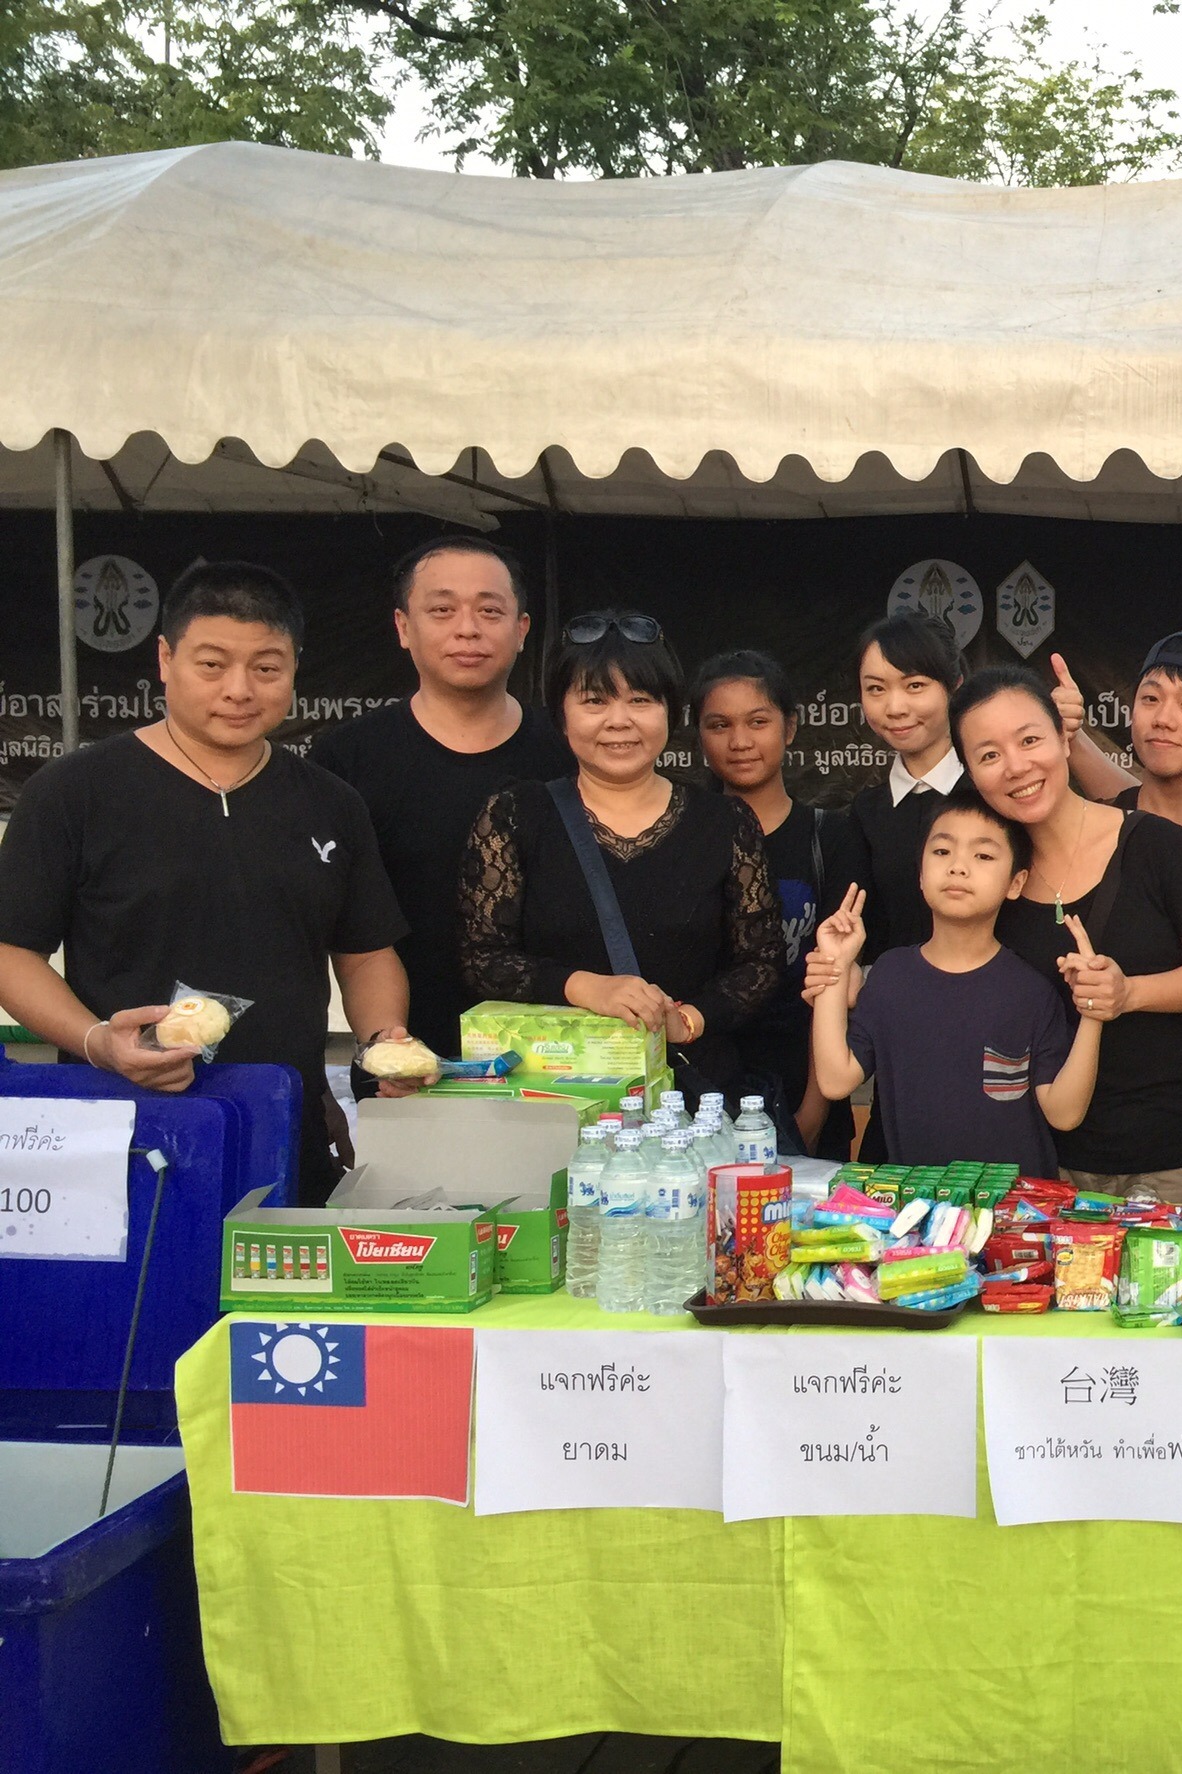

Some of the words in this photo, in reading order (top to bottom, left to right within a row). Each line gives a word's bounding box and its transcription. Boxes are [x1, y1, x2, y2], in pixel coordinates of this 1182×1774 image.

[540, 1363, 650, 1393] แจกฟรีค่ะ
[793, 1367, 901, 1395] แจกฟรีค่ะ
[1060, 1366, 1140, 1405] 台灣
[562, 1440, 628, 1462] ยาดม
[800, 1425, 889, 1463] ขนม/น้ำ
[1015, 1437, 1102, 1460] ชาวไต้หวัน
